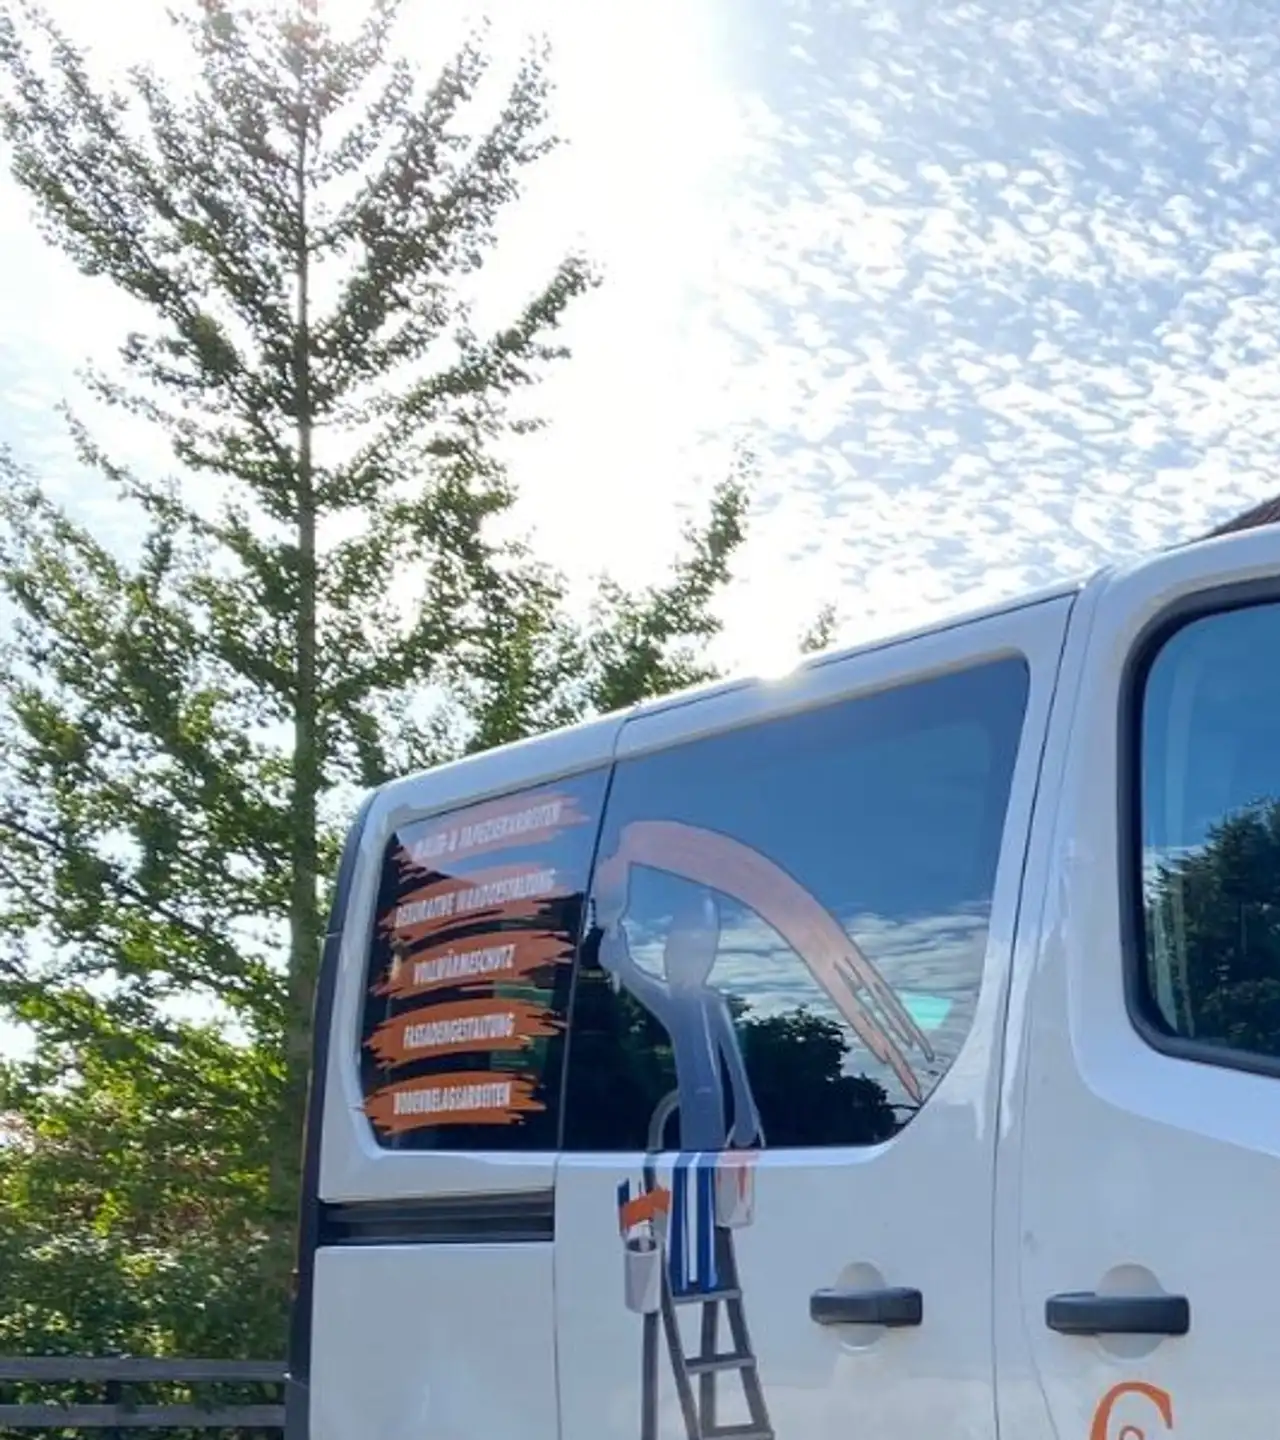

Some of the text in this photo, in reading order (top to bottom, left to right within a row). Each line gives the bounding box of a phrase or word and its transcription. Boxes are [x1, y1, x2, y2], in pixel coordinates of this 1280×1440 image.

[413, 943, 518, 986] VOLLWÄRMESCHUTZ
[402, 1011, 516, 1051] FASSADENGESTALTUNG
[392, 1082, 512, 1116] BODENBELAGSARBEITEN
